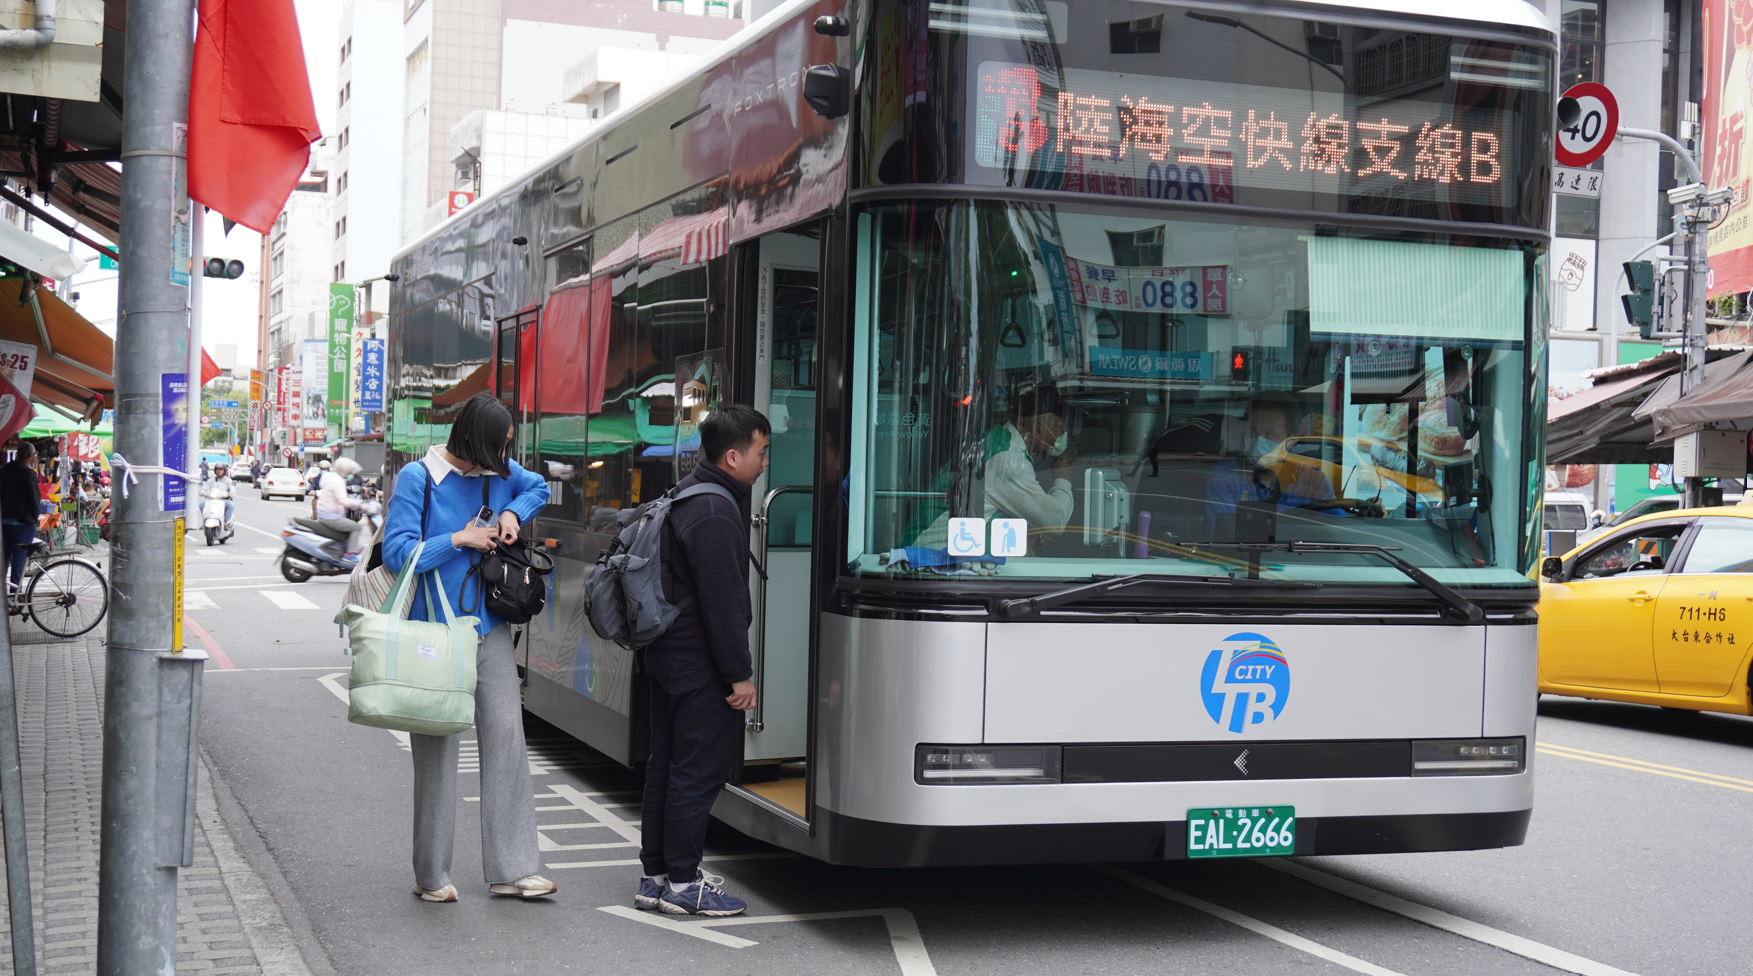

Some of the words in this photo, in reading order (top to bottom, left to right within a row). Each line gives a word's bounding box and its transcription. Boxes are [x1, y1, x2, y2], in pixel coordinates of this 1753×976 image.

[1057, 91, 1501, 184] 陸海空快線支線B
[1562, 110, 1602, 142] 40
[1671, 629, 1735, 645] 大台東合作社
[1234, 665, 1276, 679] CITY
